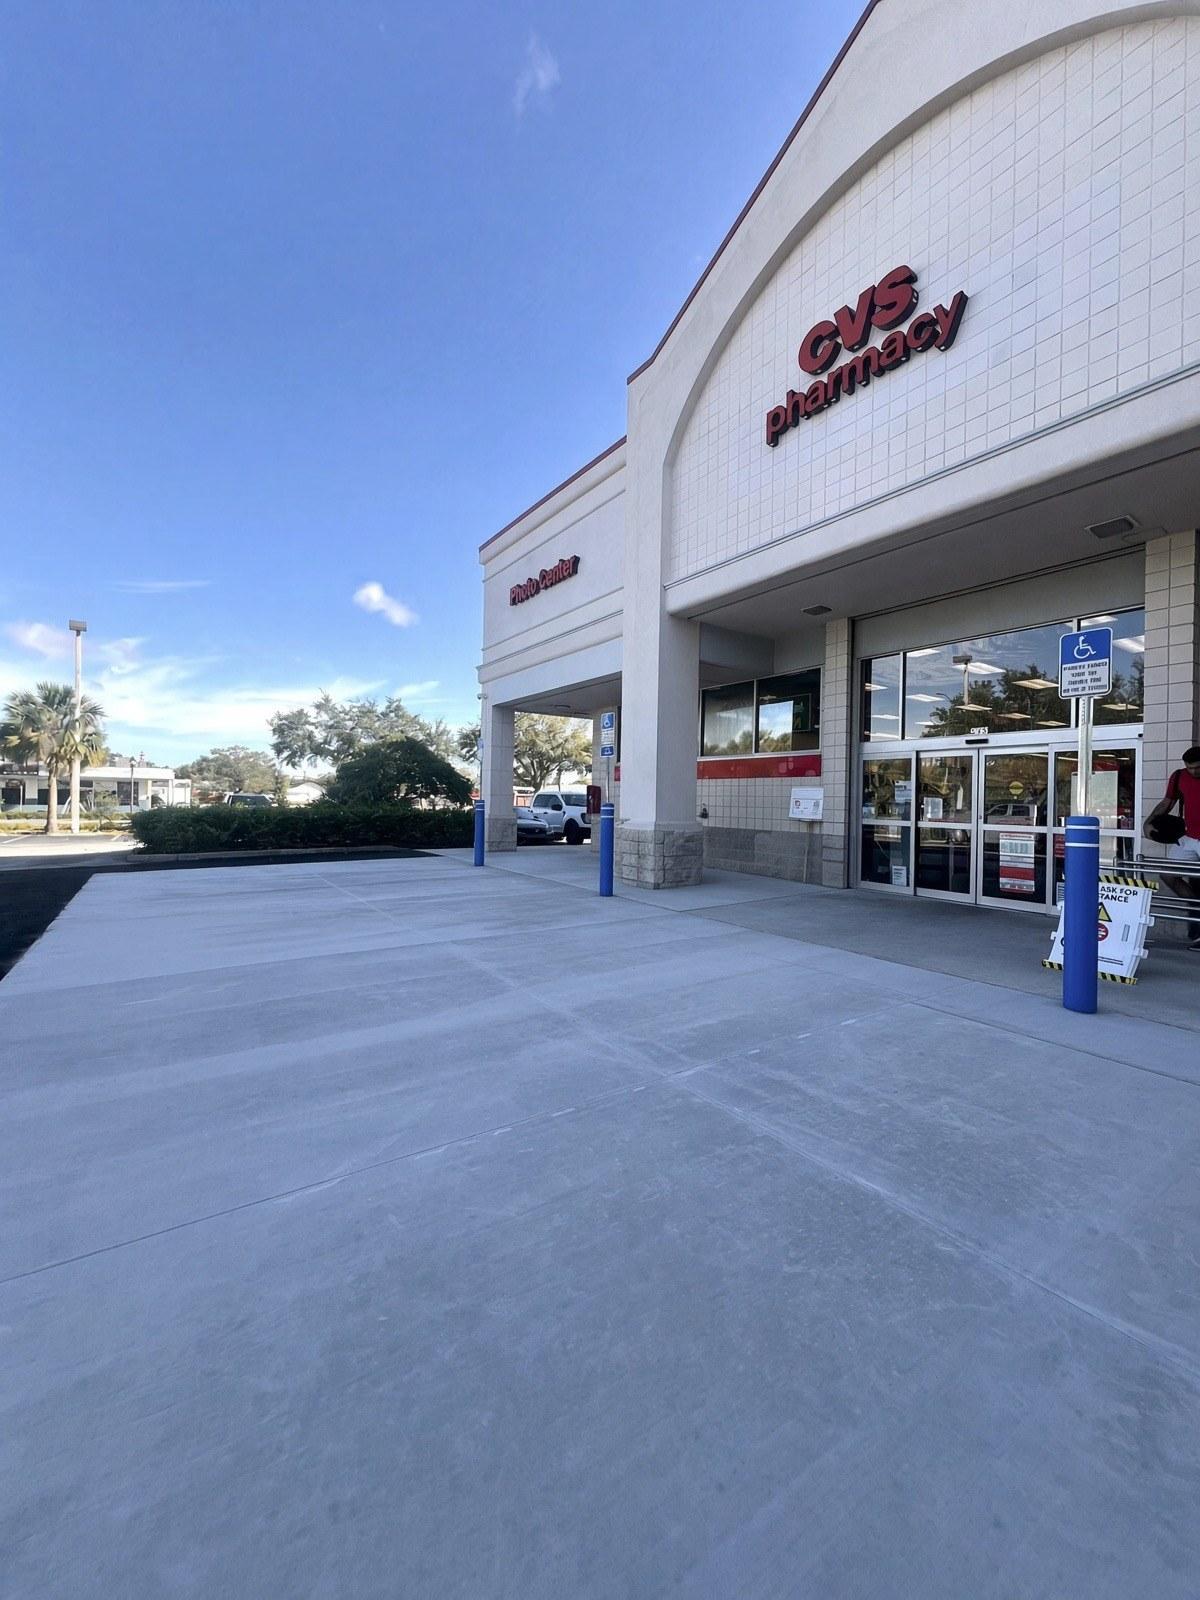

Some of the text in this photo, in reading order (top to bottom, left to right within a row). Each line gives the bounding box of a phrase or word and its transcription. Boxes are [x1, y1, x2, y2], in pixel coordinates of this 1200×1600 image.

[798, 264, 919, 375] CVS
[766, 291, 969, 447] pharmacy
[510, 554, 580, 606] Photo Center
[1098, 893, 1129, 903] TANCE
[1100, 886, 1138, 896] ASK FOR
